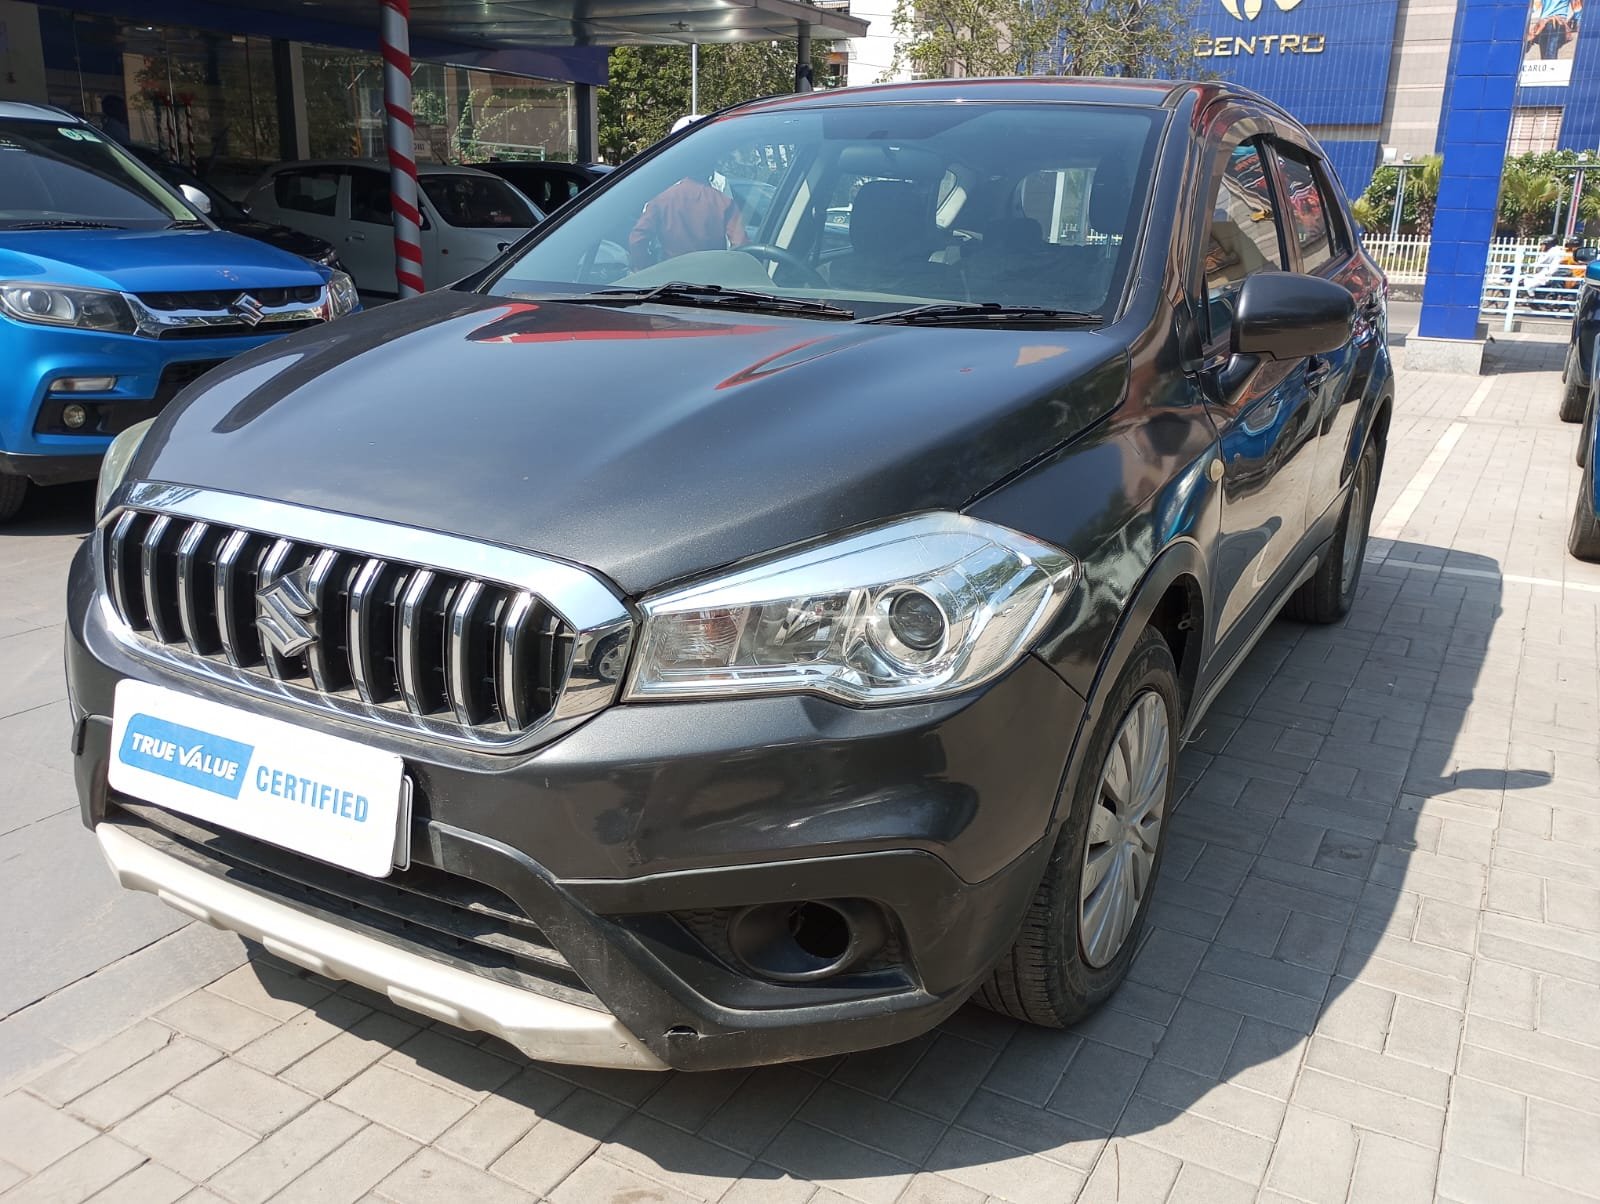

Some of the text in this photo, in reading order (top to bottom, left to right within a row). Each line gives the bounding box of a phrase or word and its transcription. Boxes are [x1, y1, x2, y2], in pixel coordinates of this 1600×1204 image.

[1194, 34, 1325, 57] CENTRO
[132, 731, 240, 782] TRUE VALUE
[256, 765, 369, 823] CERTIFIED
